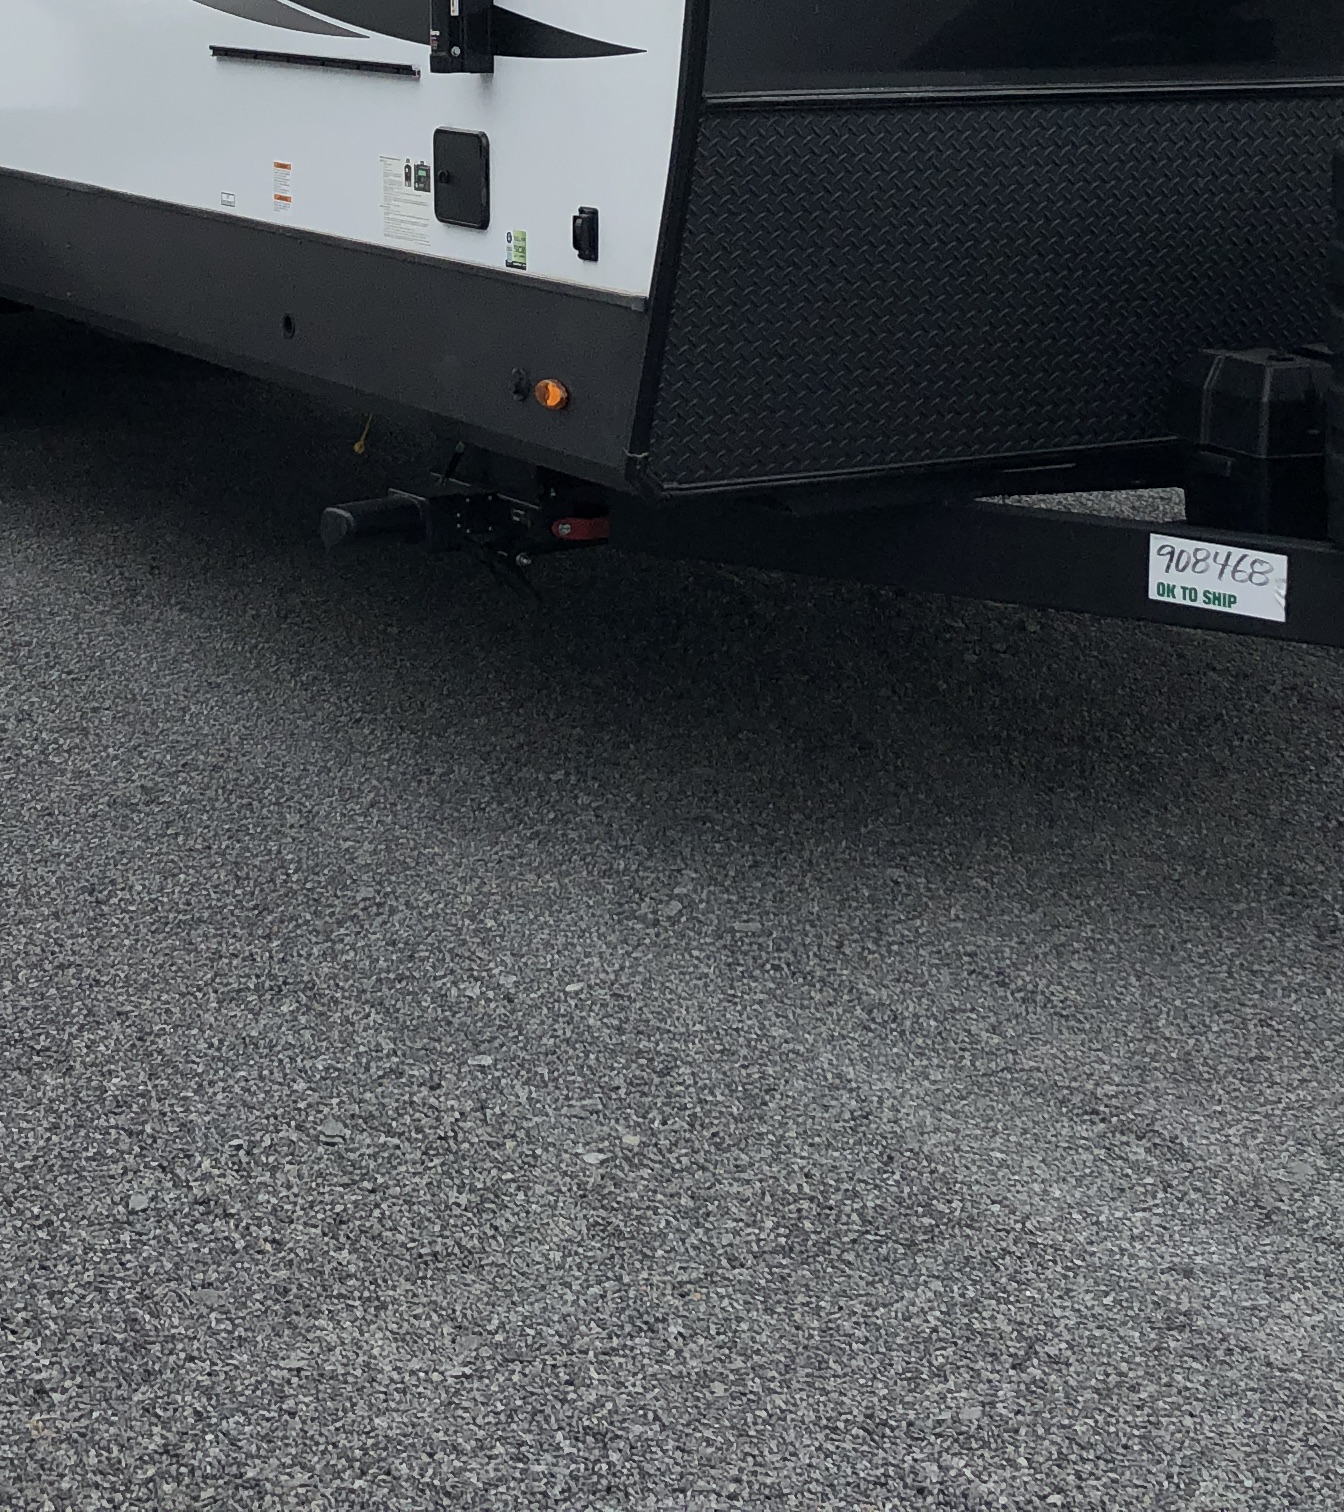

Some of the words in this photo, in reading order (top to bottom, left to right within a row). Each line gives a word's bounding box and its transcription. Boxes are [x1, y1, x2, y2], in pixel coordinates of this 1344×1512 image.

[1156, 544, 1274, 586] 908468
[1156, 581, 1177, 599] OK
[1180, 585, 1198, 602] TO
[1202, 589, 1237, 608] SHIP
